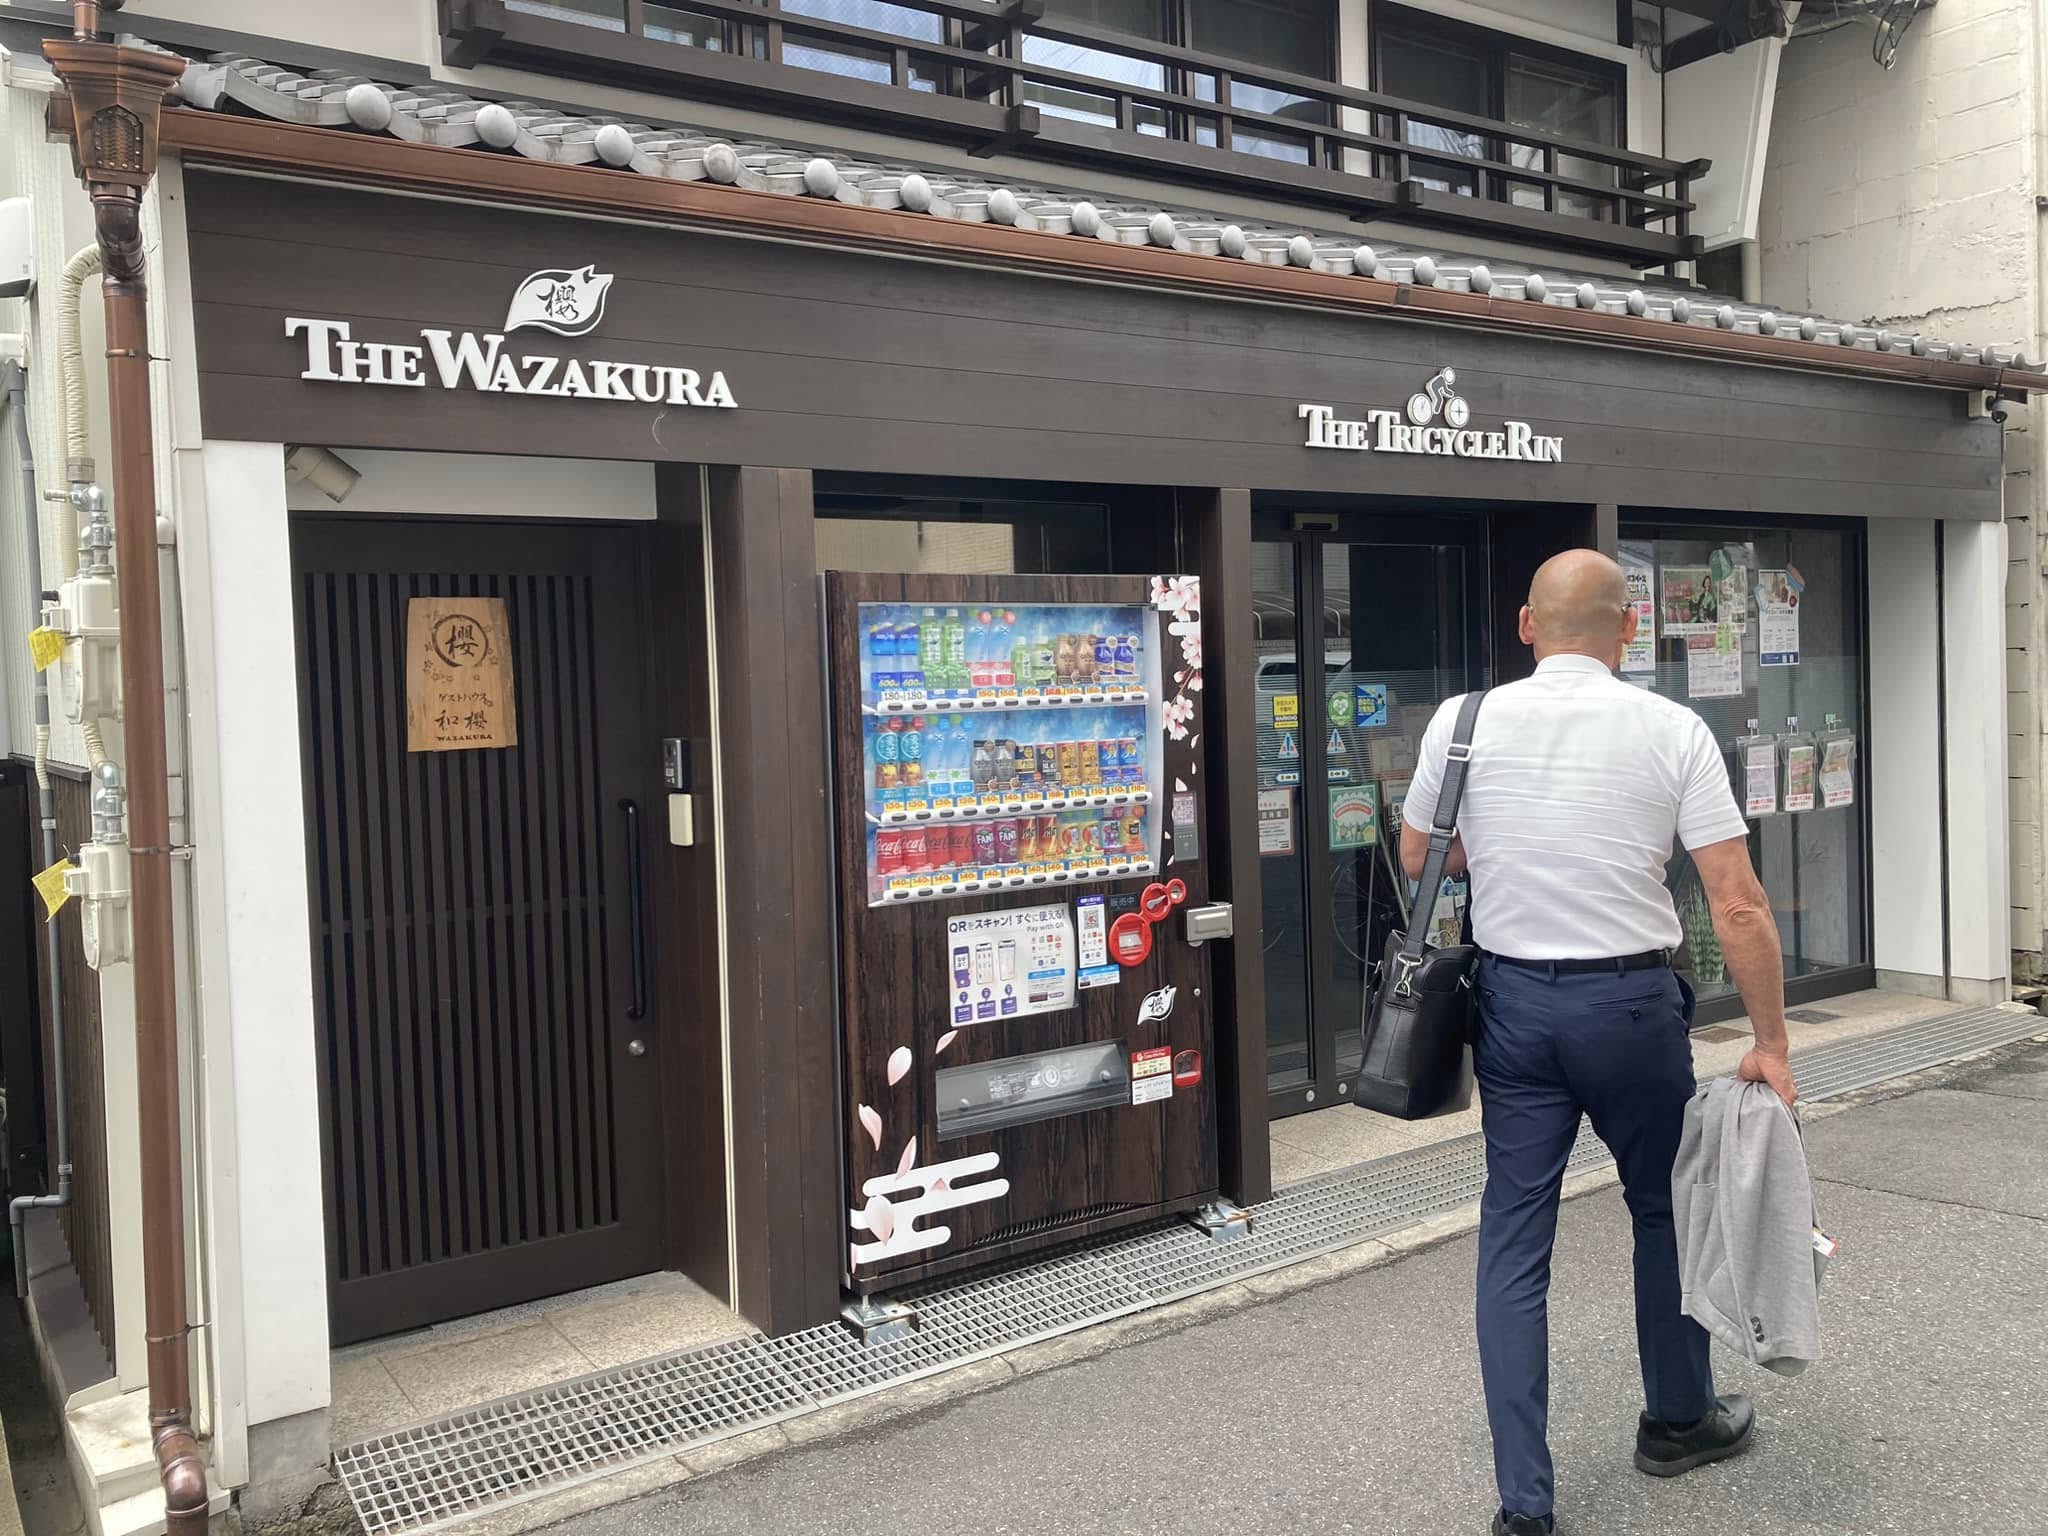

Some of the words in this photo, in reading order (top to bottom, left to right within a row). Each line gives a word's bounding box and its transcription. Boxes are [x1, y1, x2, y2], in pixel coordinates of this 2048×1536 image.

[285, 317, 426, 386] THE
[420, 328, 739, 408] WAZAKURA
[1298, 403, 1369, 450] THE
[436, 734, 493, 742] WAZAKURA
